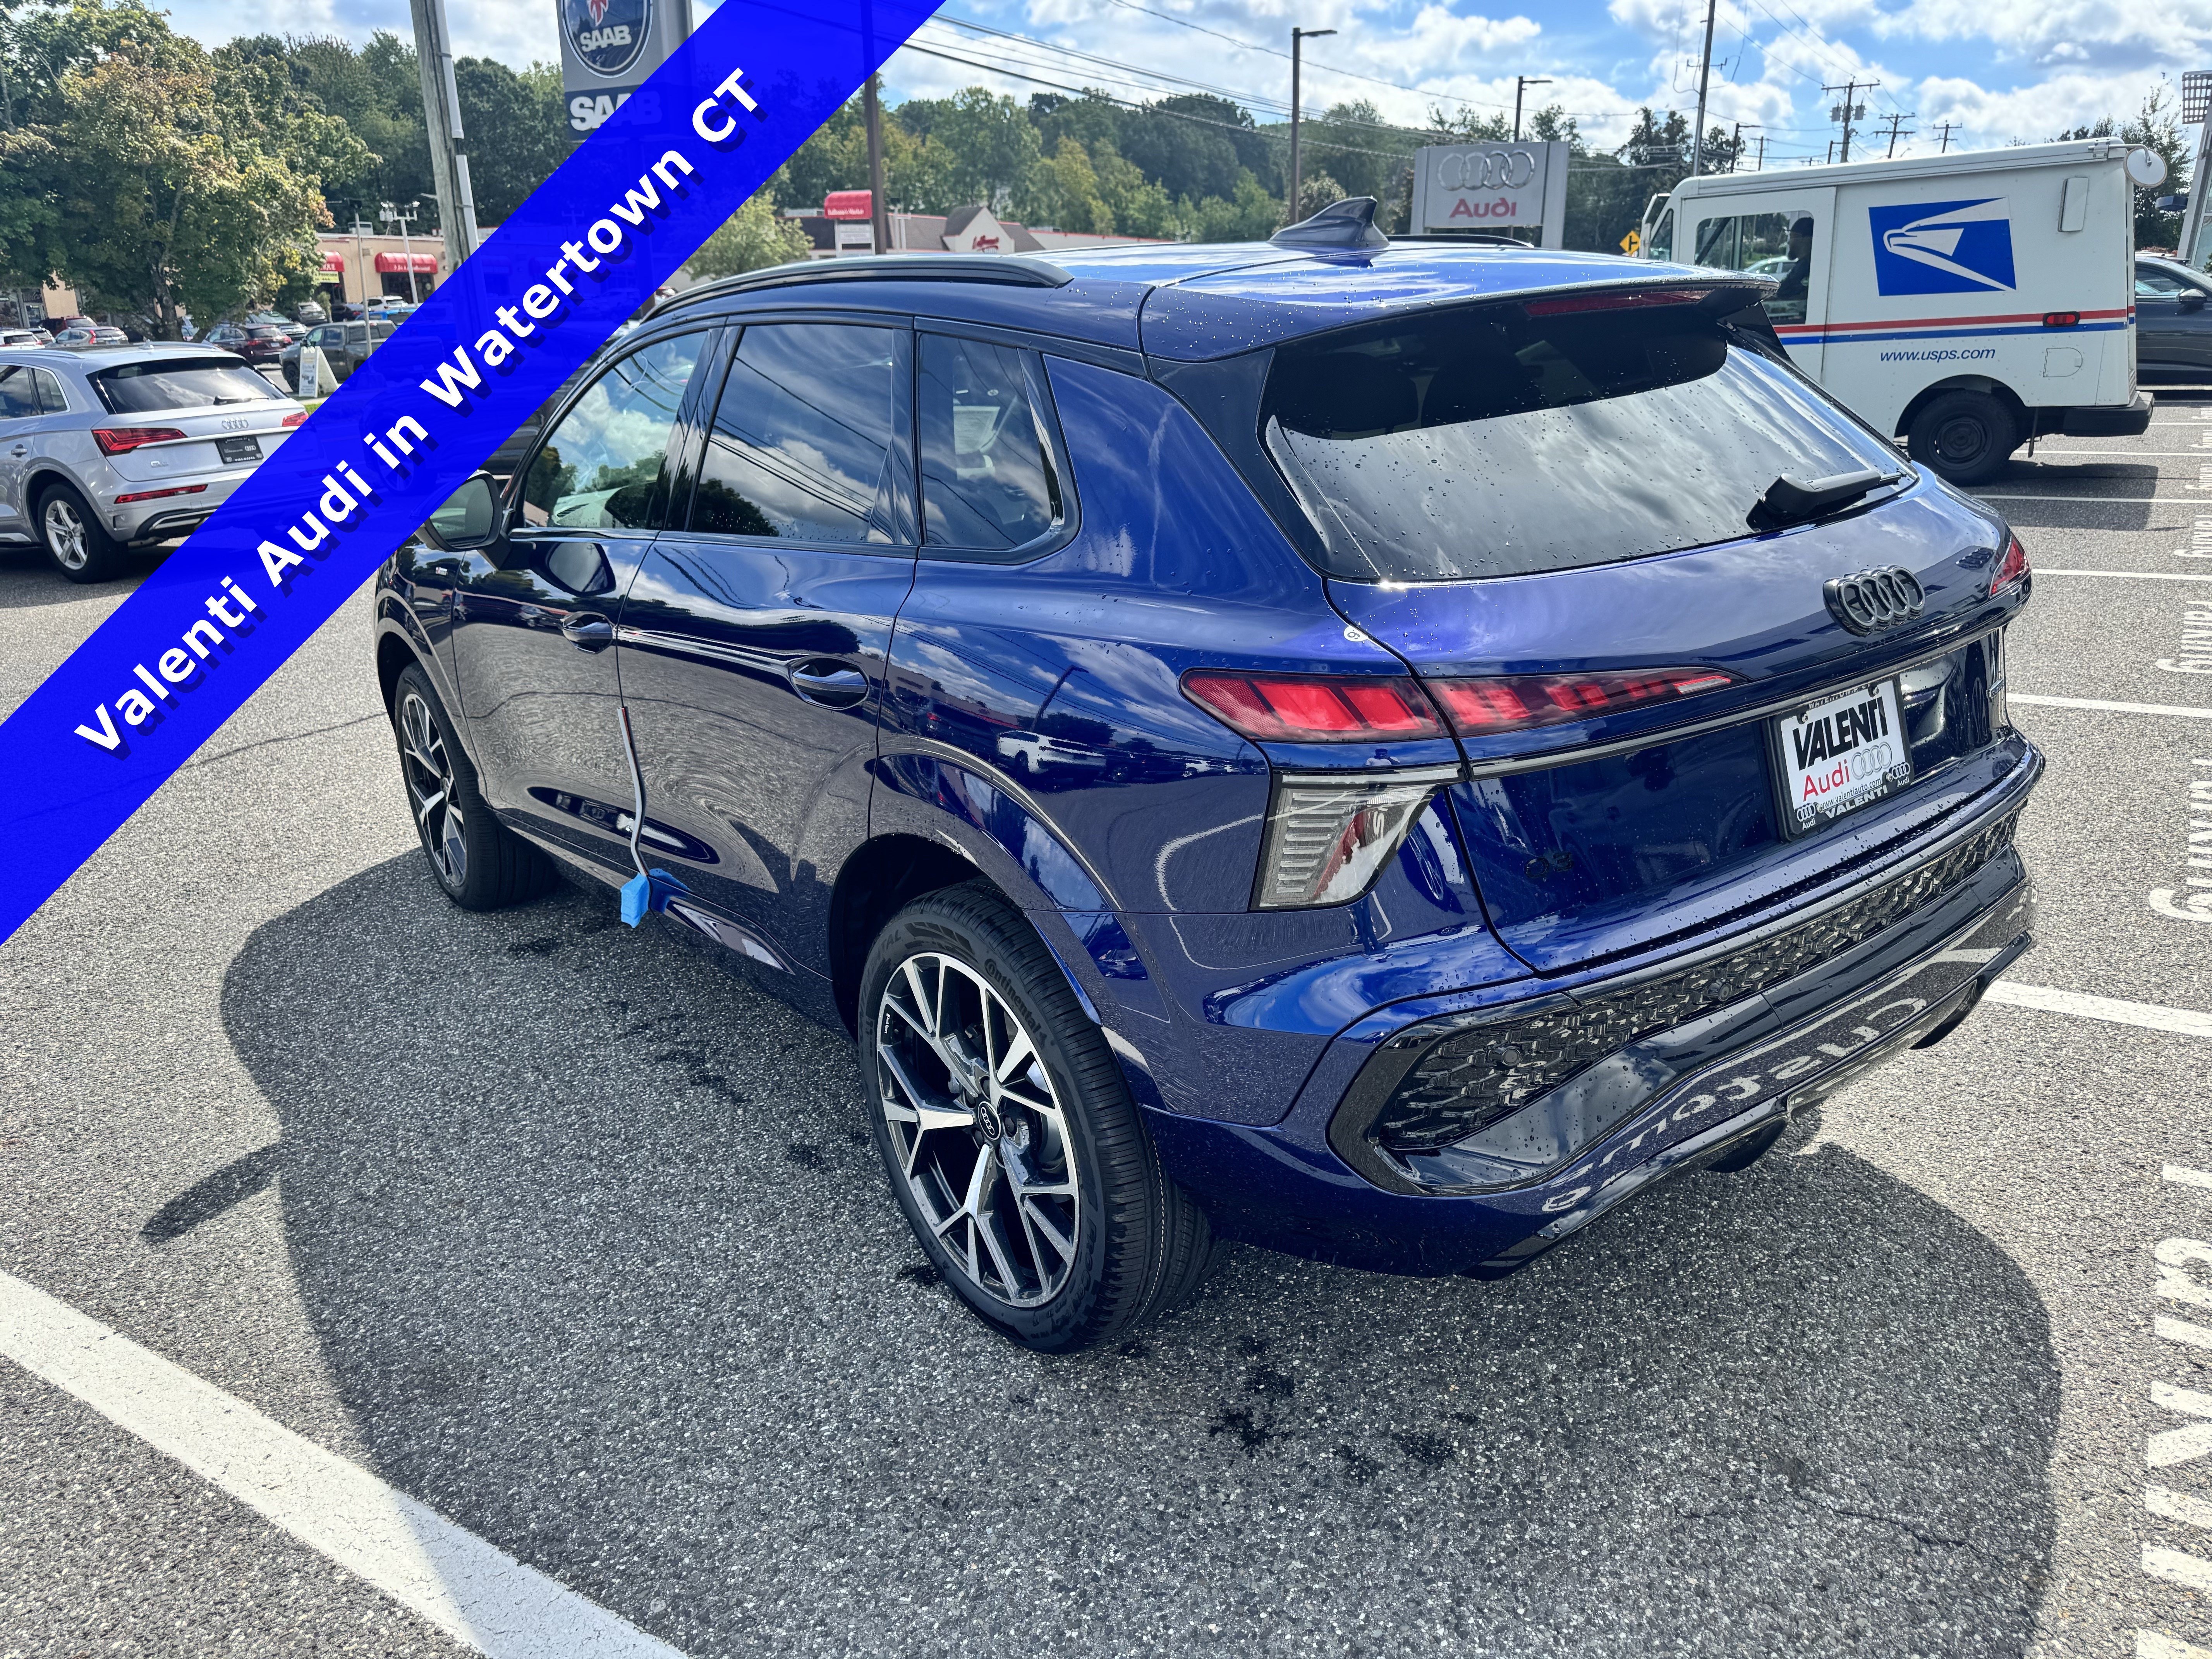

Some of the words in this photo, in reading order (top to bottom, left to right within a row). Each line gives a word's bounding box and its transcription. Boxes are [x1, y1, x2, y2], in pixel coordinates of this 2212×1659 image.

[580, 25, 632, 53] SAAB
[1449, 197, 1517, 218] Audi
[1881, 349, 1996, 363] www.usps.com
[1793, 696, 1888, 771] VALENTI
[1803, 759, 1850, 802] Audi
[1897, 776, 1910, 788] Audi
[1825, 785, 1888, 819] VALENTI
[1802, 818, 1816, 830] Audi
[984, 958, 1042, 1033] Continental
